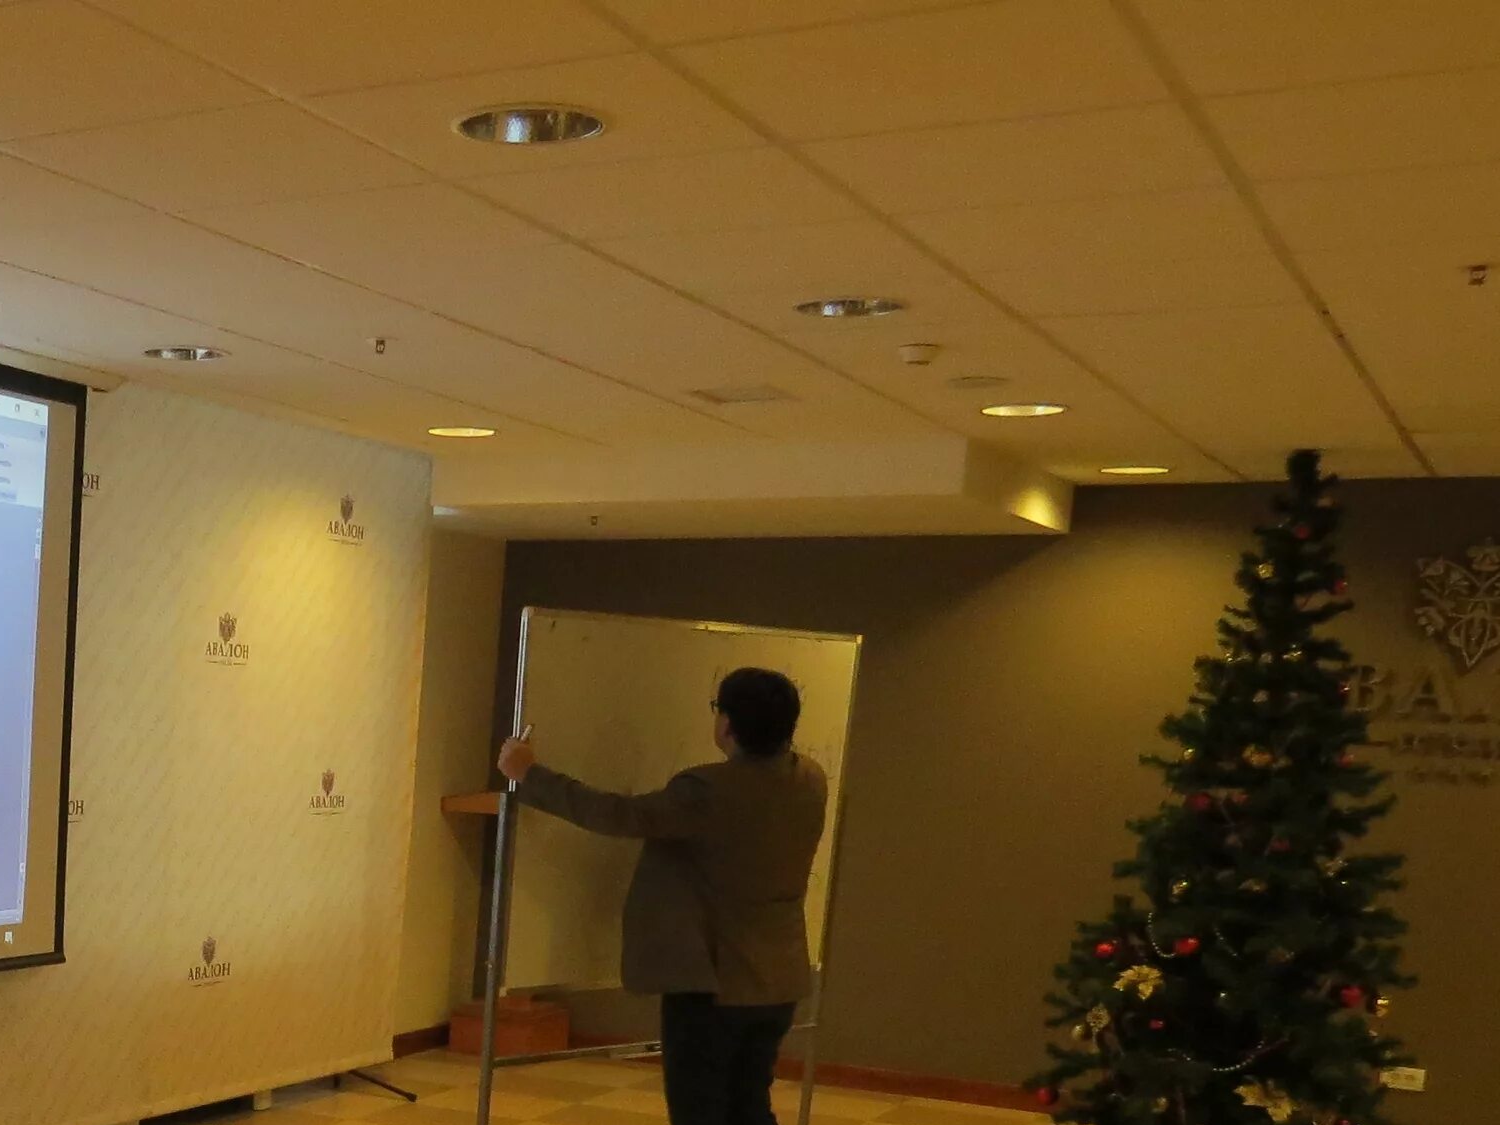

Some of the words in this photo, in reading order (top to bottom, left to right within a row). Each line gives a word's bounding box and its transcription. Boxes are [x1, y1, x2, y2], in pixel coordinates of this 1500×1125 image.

[327, 520, 365, 540] АВАЛОН
[205, 641, 250, 660] АВАЛОН
[308, 795, 346, 809] АВАЛОН
[187, 962, 232, 982] АВАЛОН
